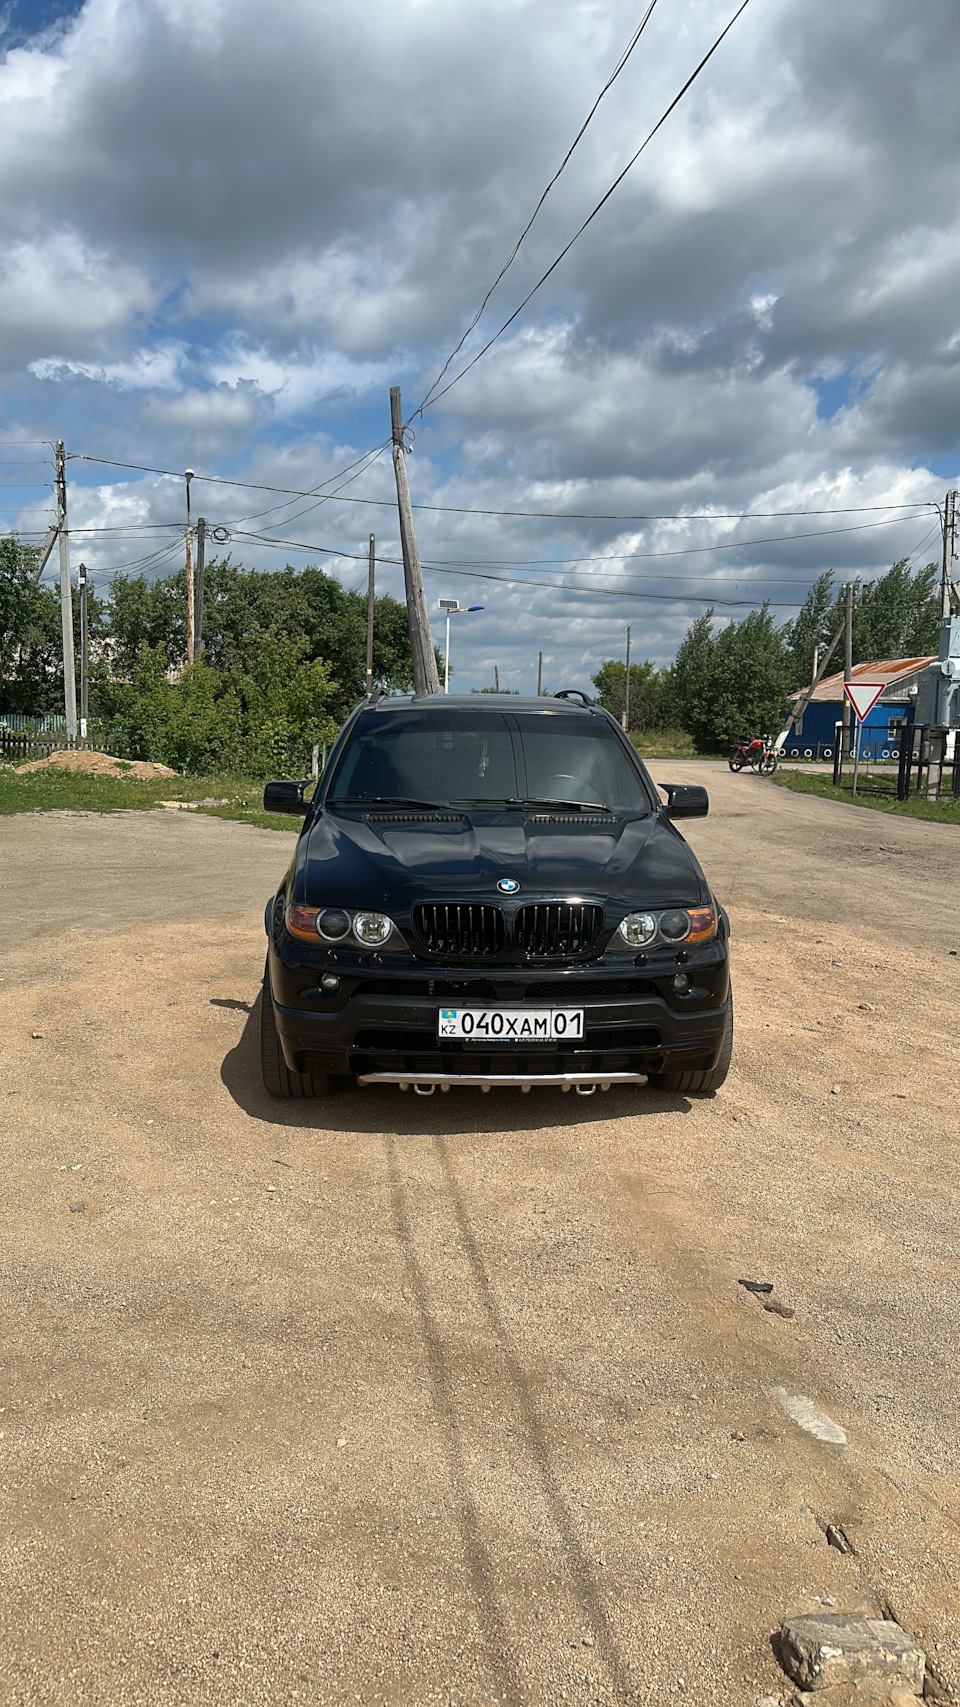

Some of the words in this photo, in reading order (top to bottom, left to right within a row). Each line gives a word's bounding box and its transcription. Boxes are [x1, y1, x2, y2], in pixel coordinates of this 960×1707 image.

[441, 1024, 456, 1034] KZ
[461, 1012, 548, 1035] 040XAM
[553, 1012, 581, 1035] 01
